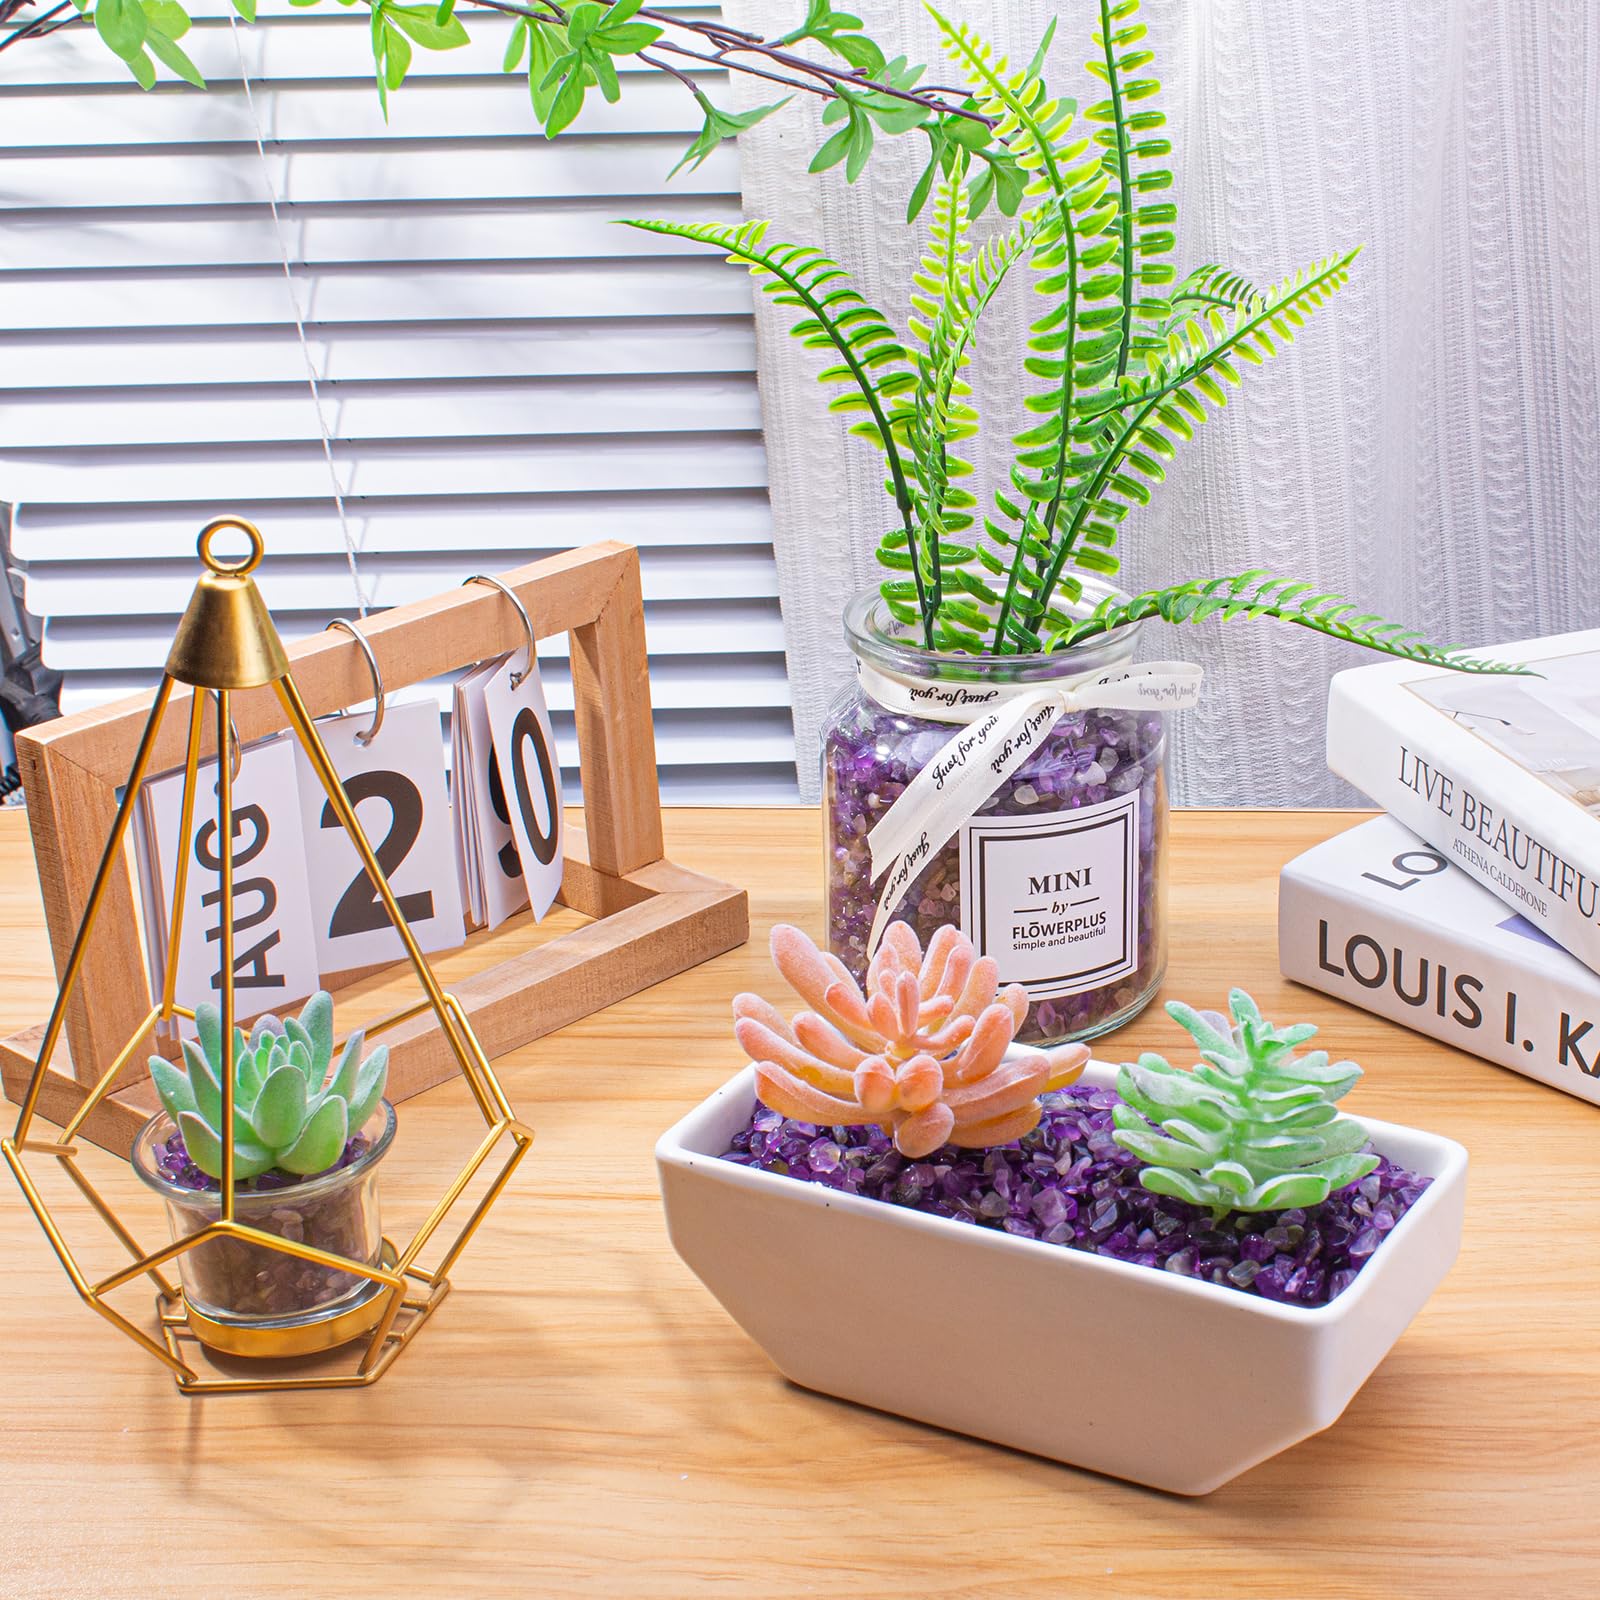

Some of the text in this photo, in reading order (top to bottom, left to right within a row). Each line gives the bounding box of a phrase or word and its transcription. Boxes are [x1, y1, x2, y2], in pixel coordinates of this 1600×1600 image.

[511, 707, 558, 865] 0
[957, 737, 976, 766] for
[320, 770, 435, 939] 2
[1361, 842, 1448, 891] LO
[1398, 746, 1600, 927] LIVE BEAUTIFU
[194, 803, 286, 991] AUG
[1028, 867, 1092, 896] MINI
[1051, 901, 1069, 916] by
[1452, 838, 1548, 918] ATHENA CALDERONE
[1012, 926, 1106, 951] simple and beautiful
[1318, 919, 1485, 1029] LOUIS
[1505, 991, 1534, 1053] I.
